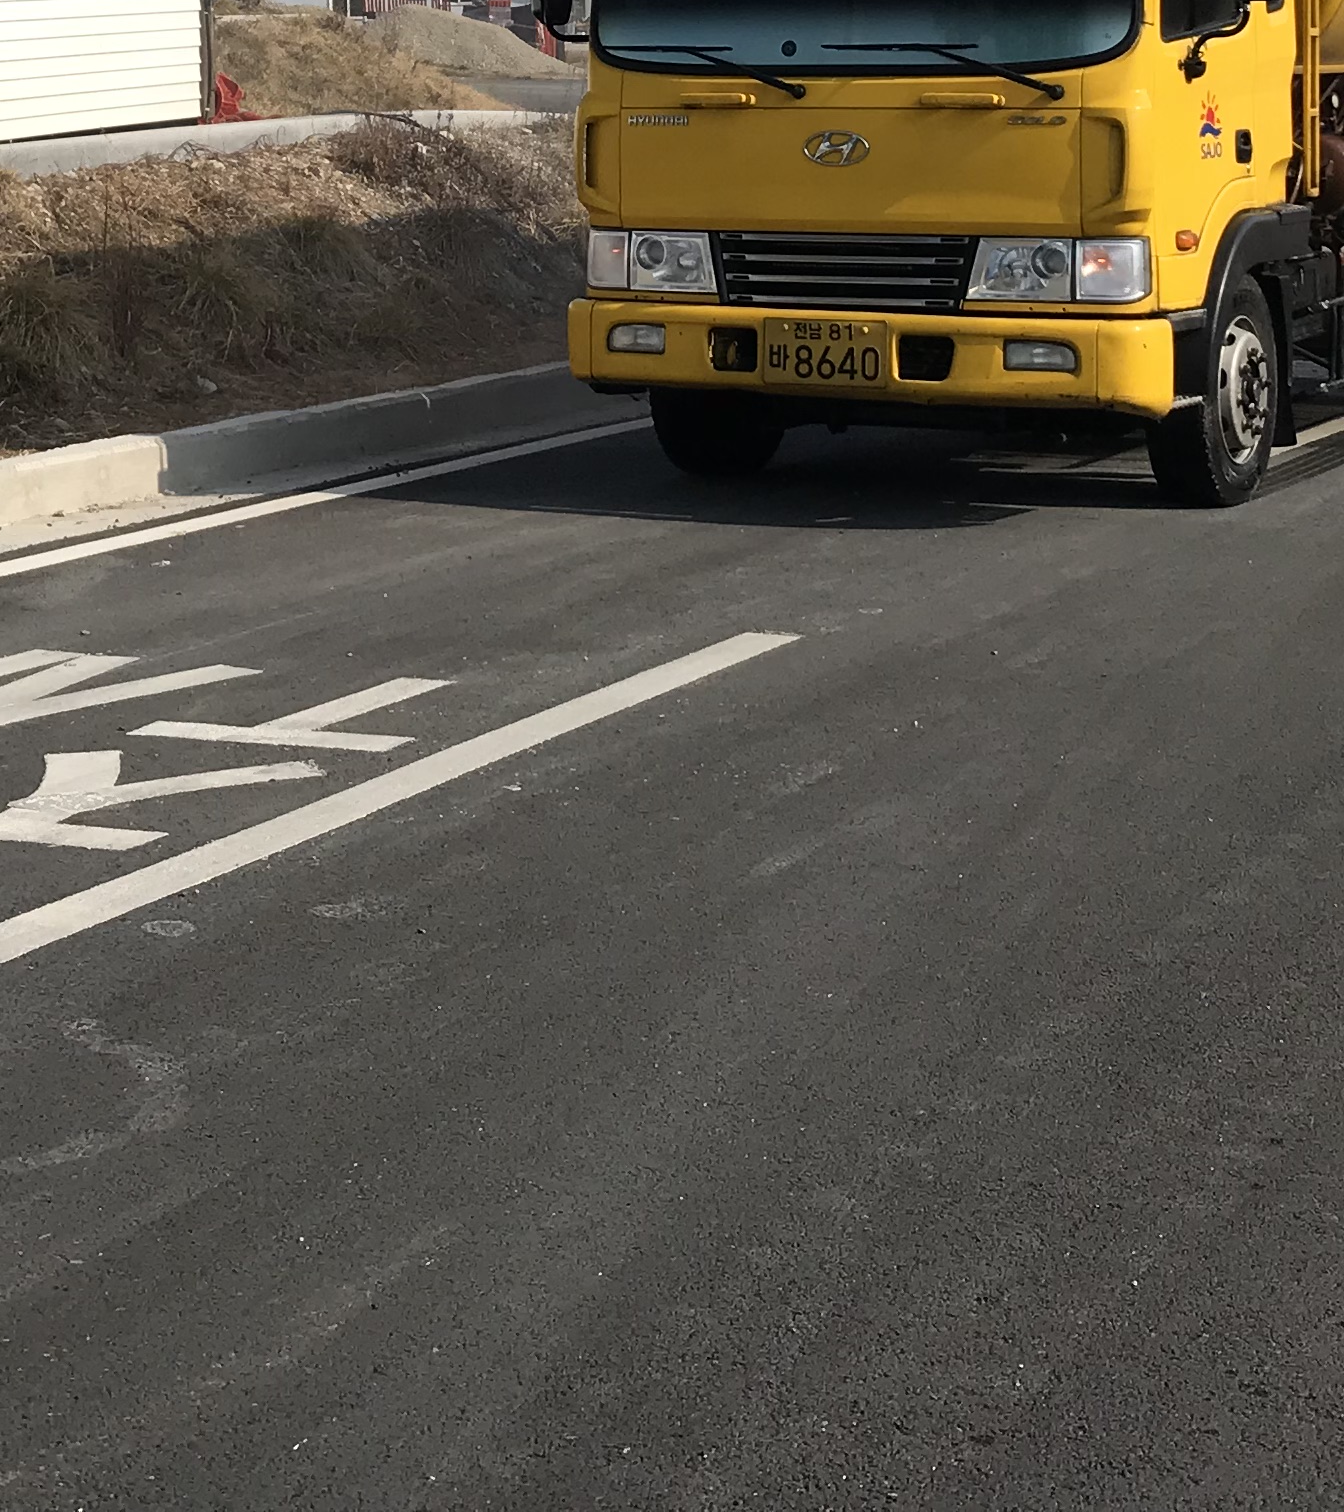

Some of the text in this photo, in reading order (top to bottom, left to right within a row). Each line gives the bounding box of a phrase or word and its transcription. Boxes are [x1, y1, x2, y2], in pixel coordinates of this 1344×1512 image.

[627, 114, 689, 127] HYUNDAI
[1200, 141, 1223, 160] SAJO
[794, 322, 854, 341] 전남 81
[768, 343, 881, 382] 바 8640
